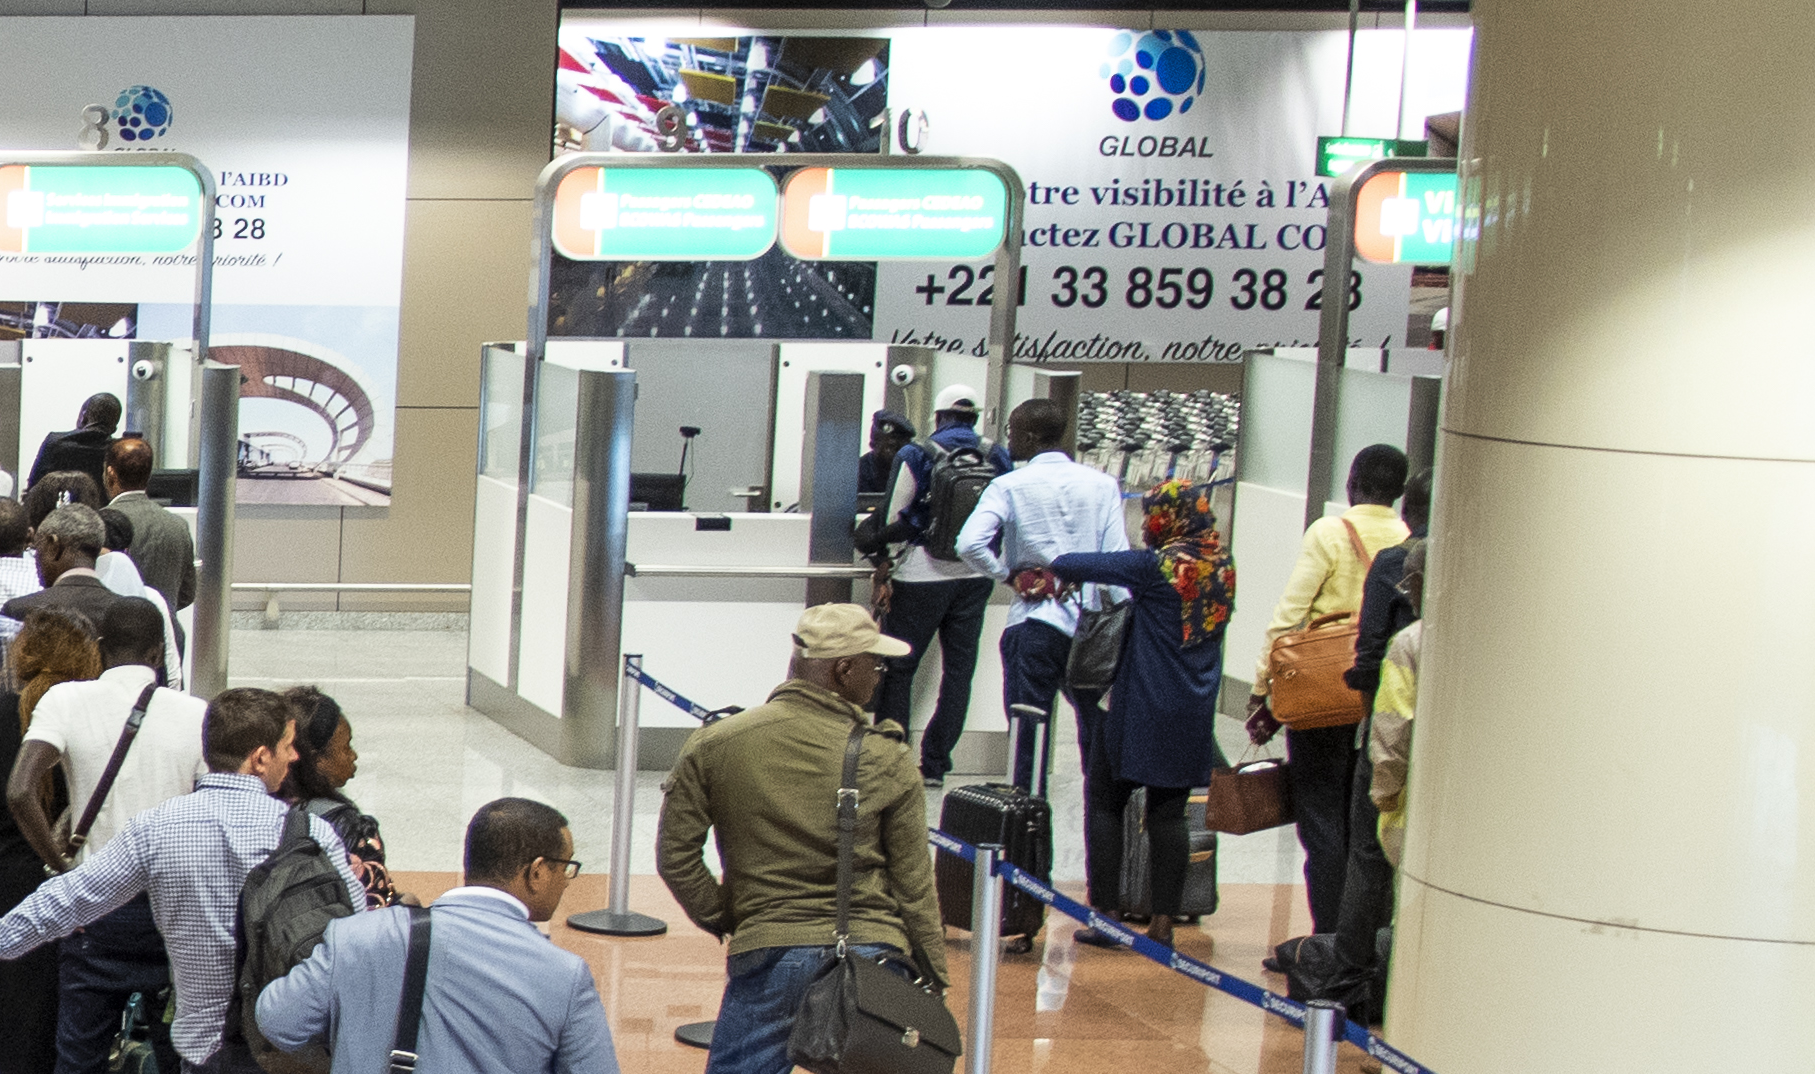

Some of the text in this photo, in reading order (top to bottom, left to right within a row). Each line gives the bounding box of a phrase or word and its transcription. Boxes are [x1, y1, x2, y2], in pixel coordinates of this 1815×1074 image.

[77, 103, 110, 151] 8
[655, 105, 688, 153] 9
[1098, 135, 1215, 158] GLOBAL
[215, 194, 266, 208] COM
[1023, 182, 1080, 207] tre
[1089, 178, 1245, 208] visibilité
[1256, 182, 1277, 208] à
[233, 218, 266, 240] 28
[1108, 221, 1268, 250] GLOBAL
[212, 252, 267, 267] riorité
[1051, 266, 1109, 309] 33
[1125, 266, 1215, 311] 859
[1230, 268, 1288, 311] 38
[972, 328, 1152, 363] stisfaction,
